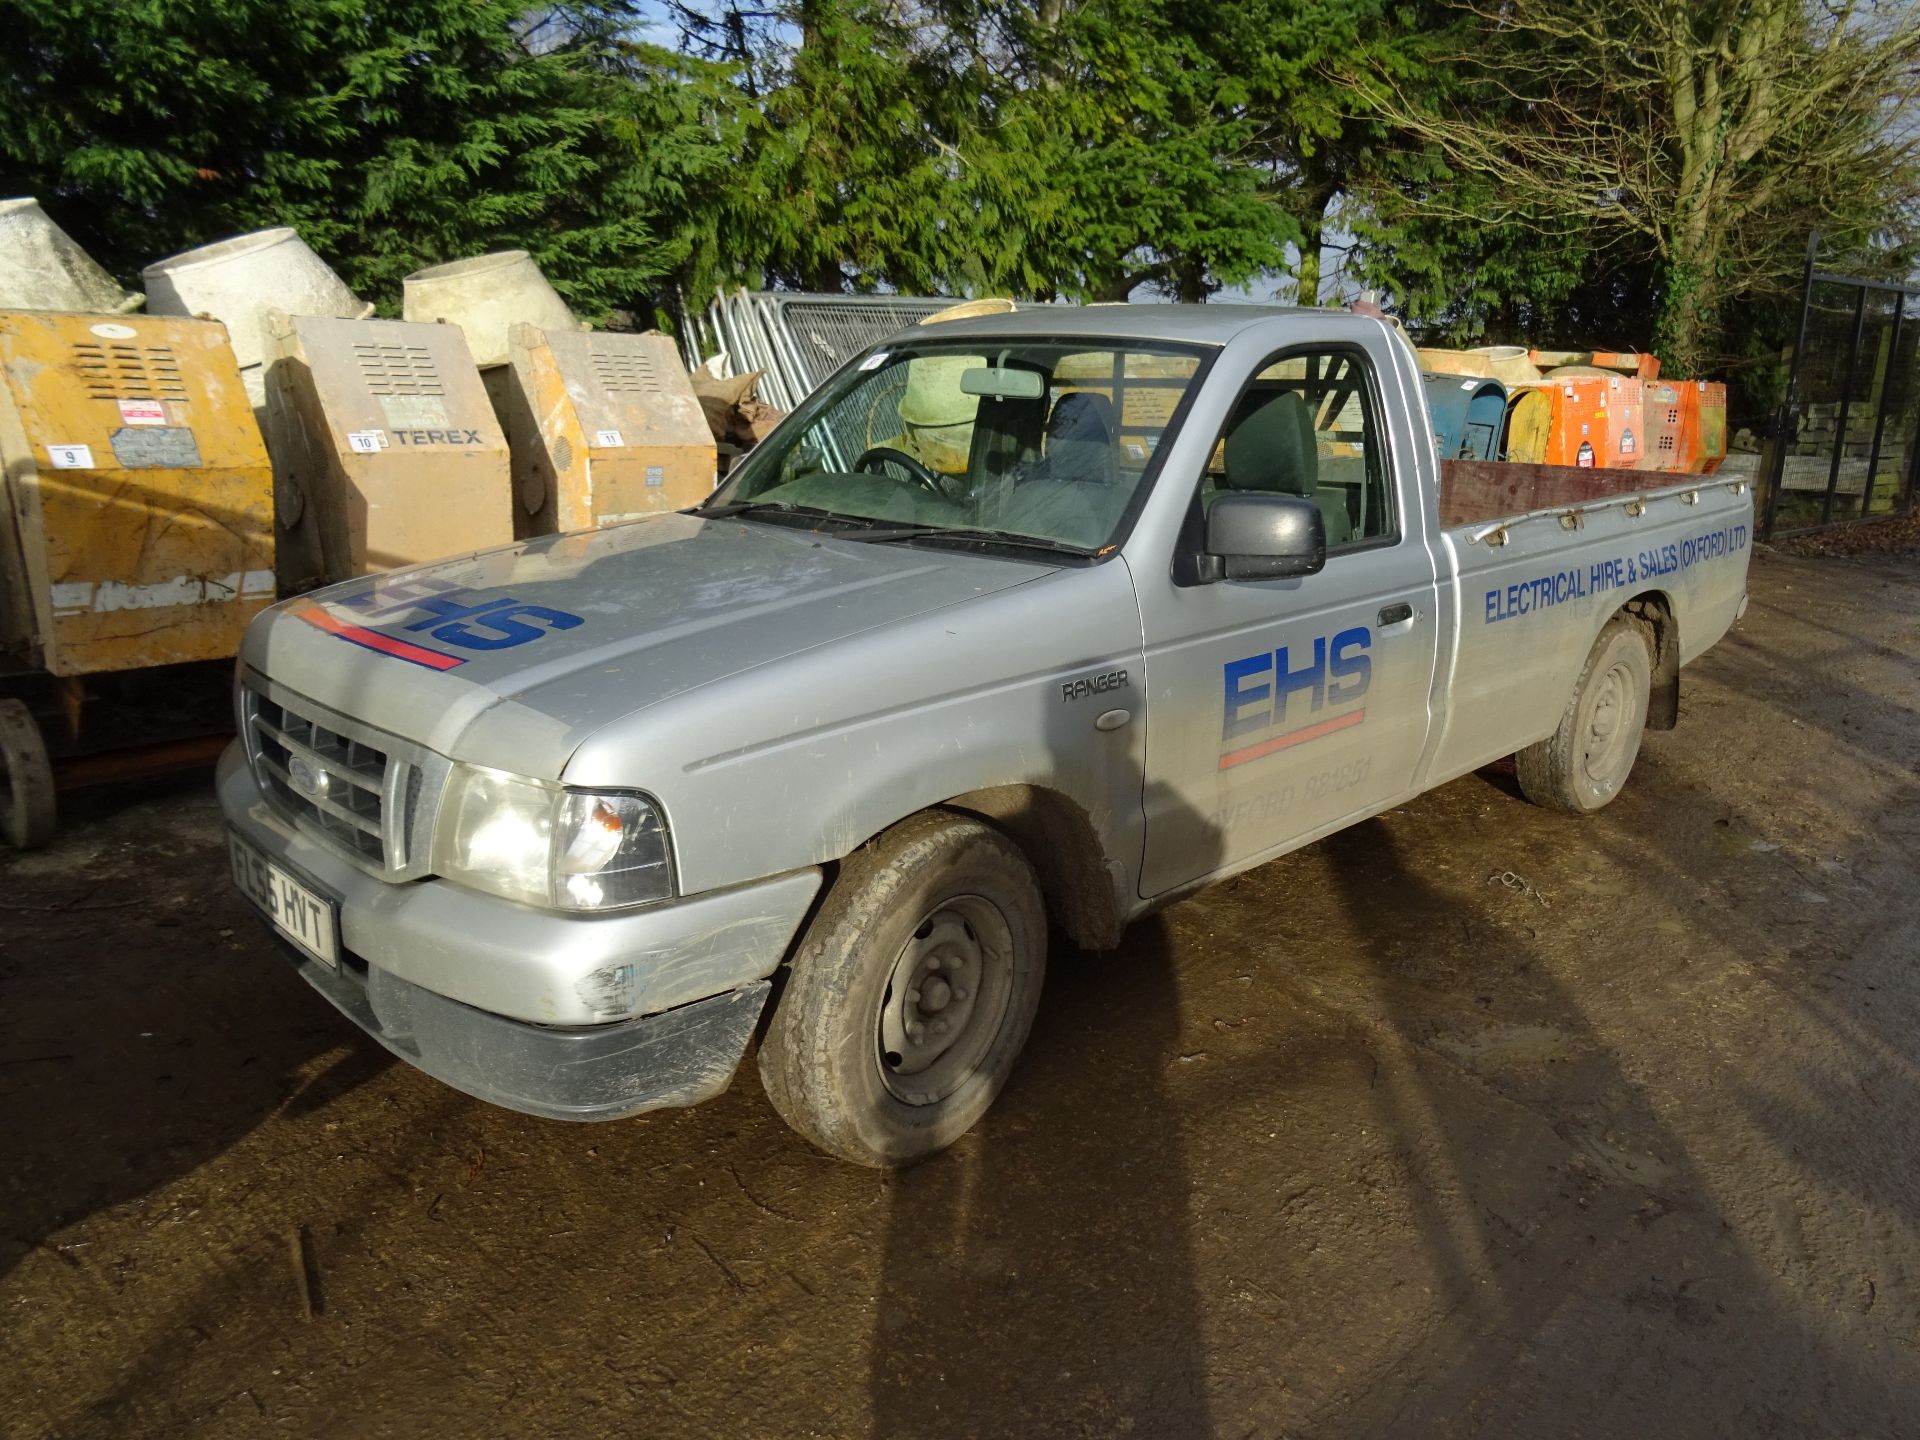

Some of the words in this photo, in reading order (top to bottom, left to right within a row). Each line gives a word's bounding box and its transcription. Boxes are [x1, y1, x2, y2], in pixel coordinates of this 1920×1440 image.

[357, 438, 372, 448] 10
[392, 430, 483, 445] TEREX
[65, 451, 76, 464] 9
[1484, 571, 1586, 625] ELECTRICAL
[1590, 558, 1625, 595] HIRE
[1627, 557, 1637, 585] &
[1638, 543, 1678, 580] SALES
[1679, 527, 1728, 569] (OXFORD)
[1728, 525, 1746, 551] LTD
[1061, 669, 1129, 702] RANGER
[1222, 626, 1372, 741] EHS
